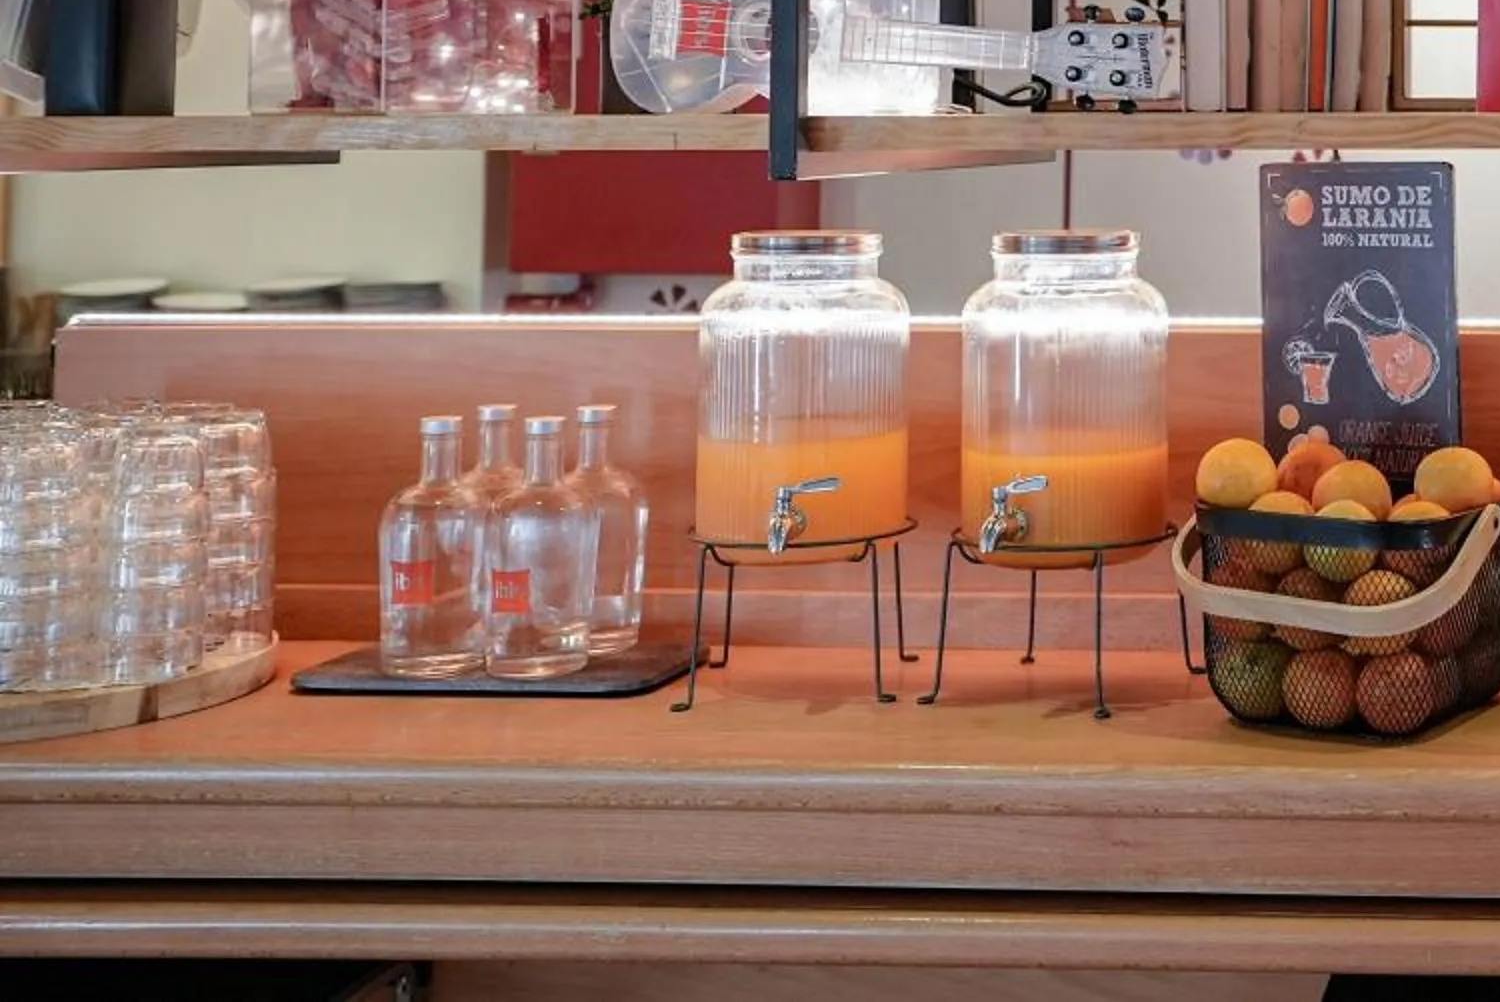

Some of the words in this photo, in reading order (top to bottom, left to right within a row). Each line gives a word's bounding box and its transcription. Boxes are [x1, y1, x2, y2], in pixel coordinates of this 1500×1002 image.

[1321, 185, 1391, 206] SUMO
[1397, 185, 1432, 206] DE
[1322, 232, 1355, 247] 100%
[1357, 232, 1434, 247] NATURAL
